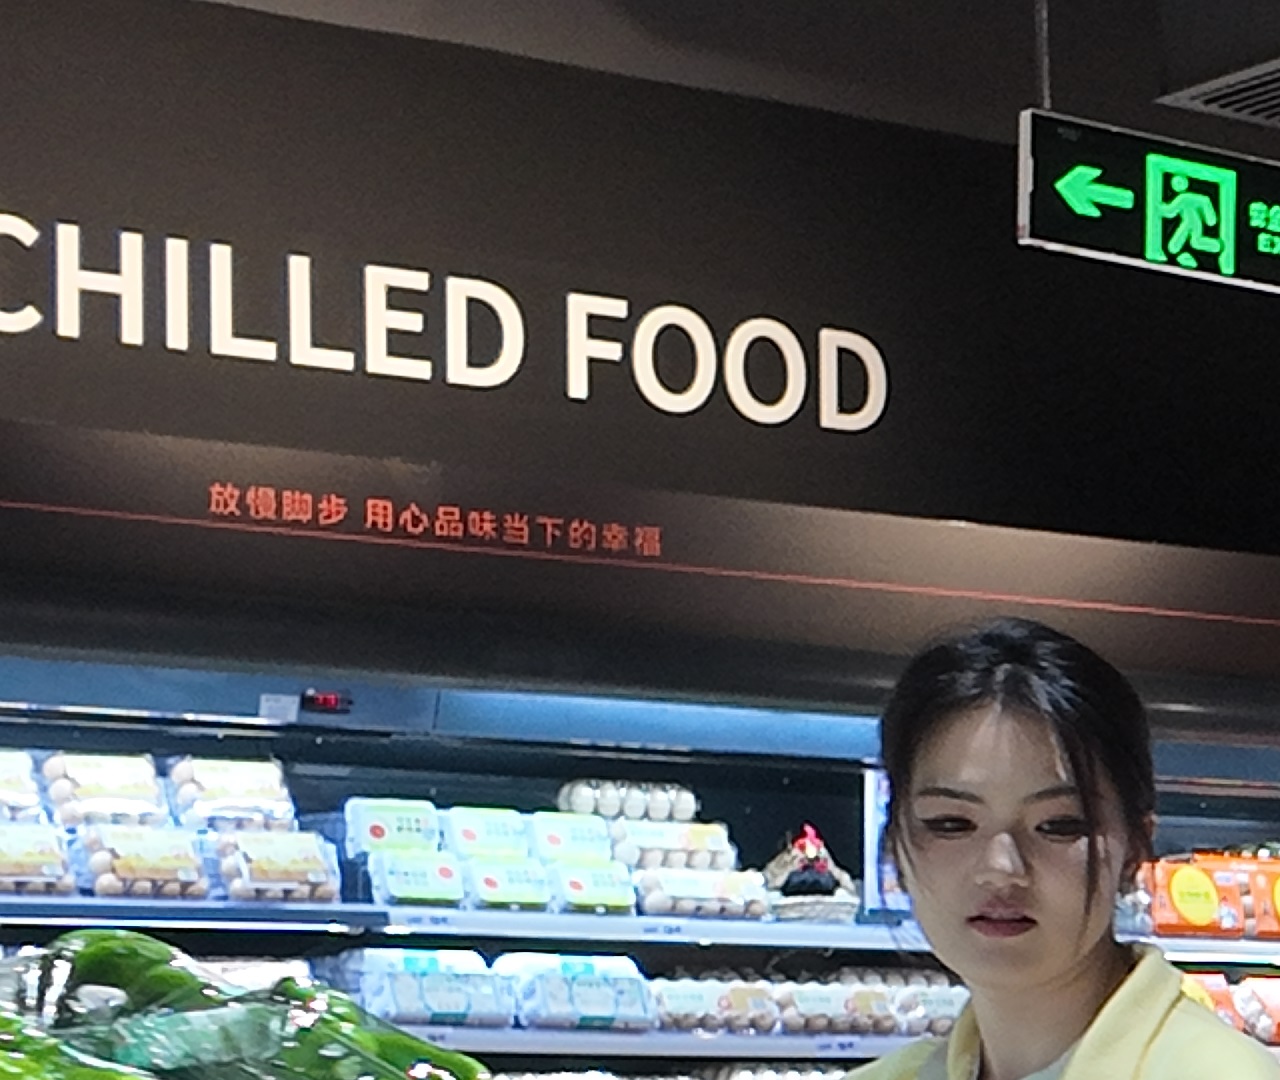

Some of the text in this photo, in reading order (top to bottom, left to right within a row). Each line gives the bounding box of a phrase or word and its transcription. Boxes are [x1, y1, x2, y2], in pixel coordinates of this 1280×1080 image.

[566, 292, 888, 432] FOOD
[207, 482, 662, 557] 放慢脚步 用心品味当下的幸福
